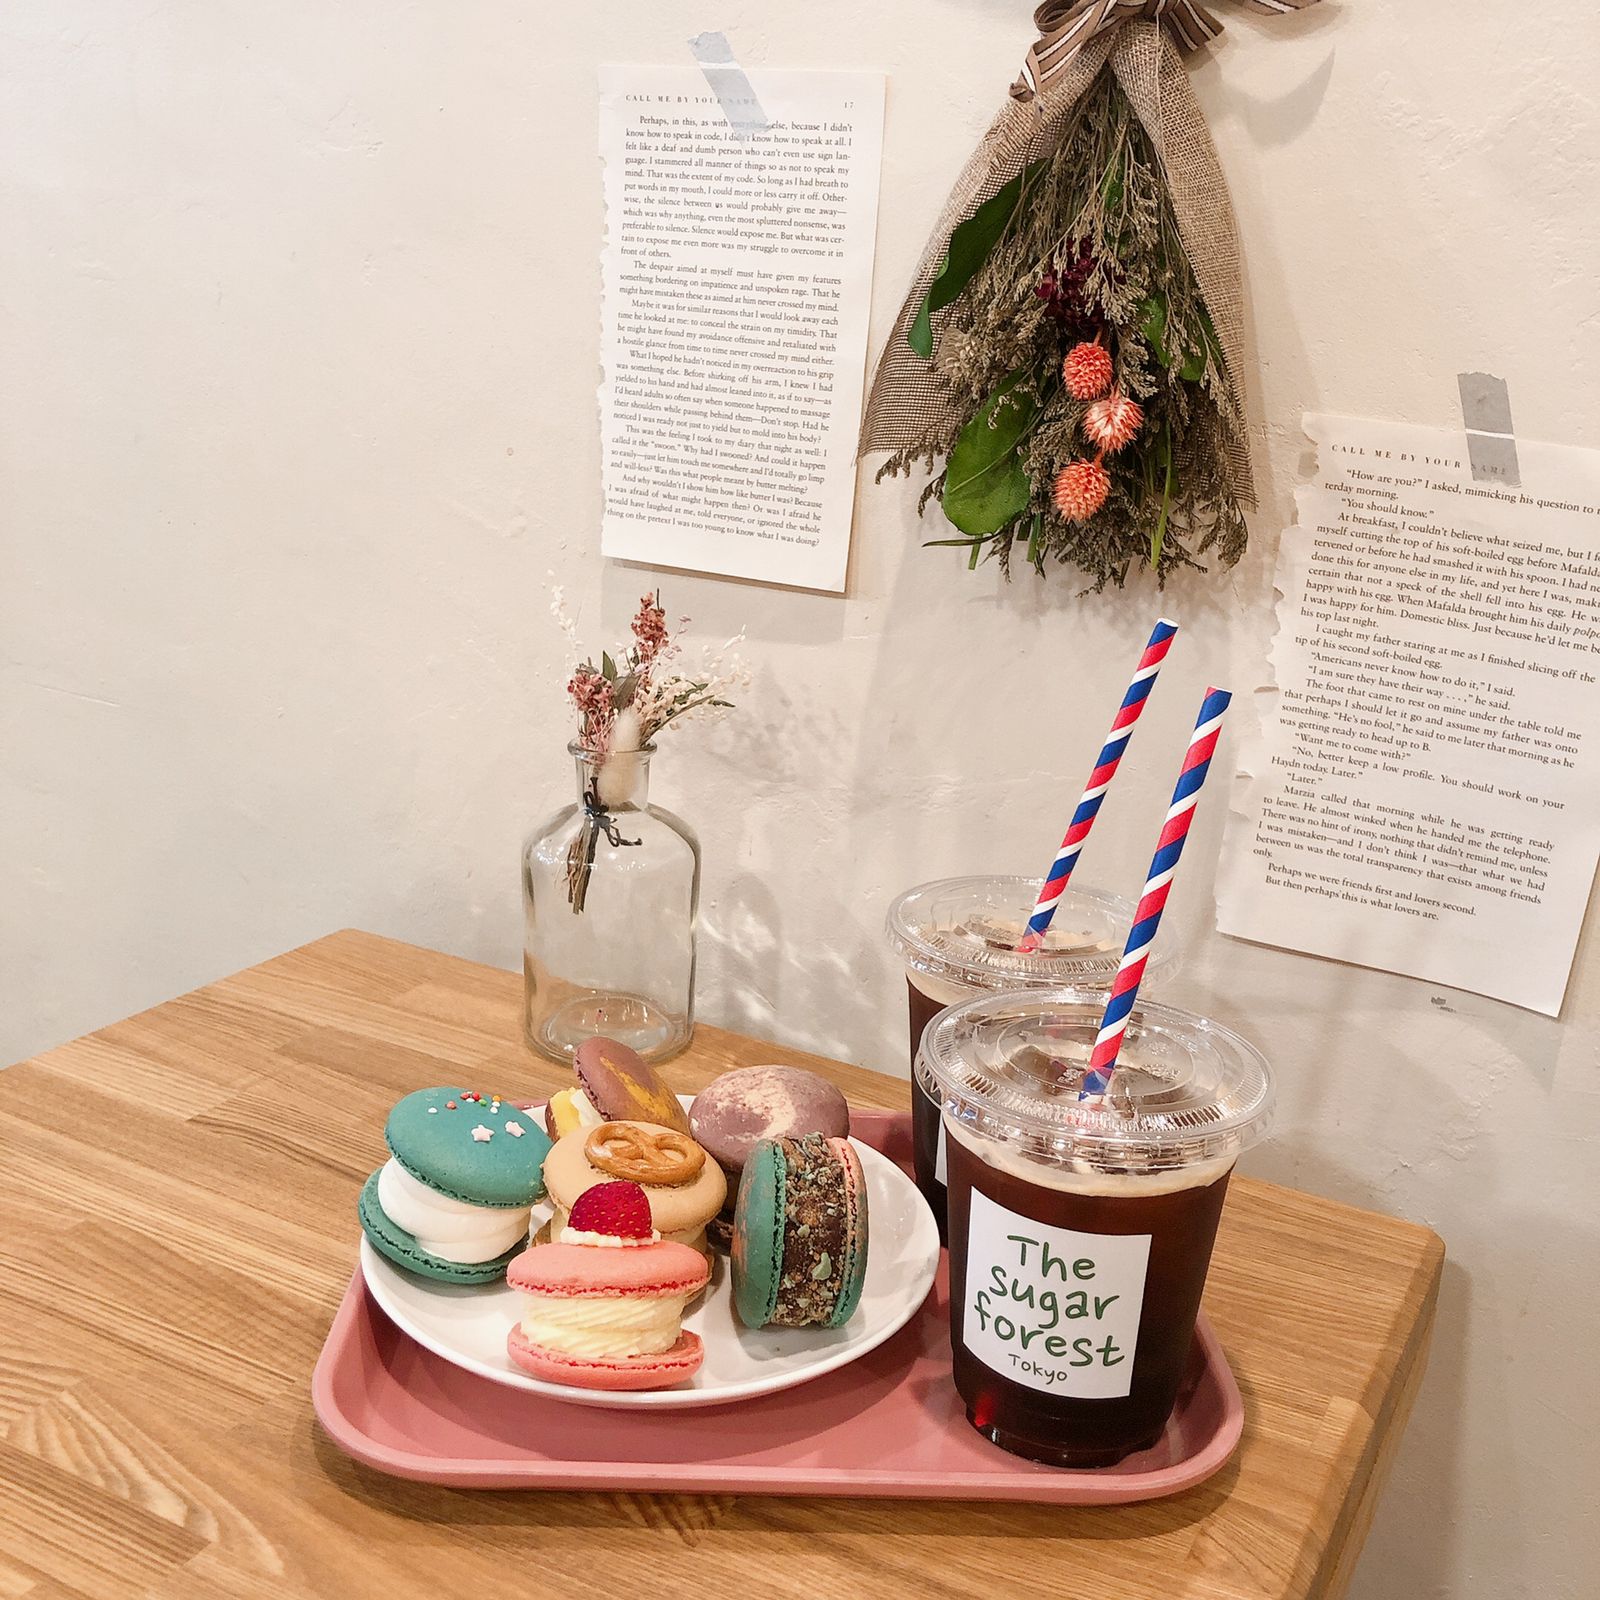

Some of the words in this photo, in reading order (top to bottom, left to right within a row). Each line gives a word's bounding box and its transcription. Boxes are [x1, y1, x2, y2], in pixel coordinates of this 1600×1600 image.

[625, 94, 651, 102] CALL
[625, 141, 637, 150] felt
[639, 141, 652, 151] like
[660, 142, 677, 152] deaf
[679, 144, 693, 153] and
[694, 144, 716, 154] dumb
[717, 148, 742, 156] person
[744, 146, 760, 156] who
[762, 148, 781, 157] can't
[817, 151, 833, 161] sign
[835, 150, 850, 160] lan-
[620, 245, 638, 255] front
[638, 247, 647, 256] of
[634, 260, 647, 269] The
[648, 261, 674, 272] despair
[676, 264, 697, 273] aimed
[710, 267, 733, 277] myself
[736, 270, 754, 278] must
[756, 269, 773, 279] have
[775, 271, 794, 282] given
[797, 275, 809, 284] my
[812, 274, 842, 285] features
[614, 385, 624, 394] I'd
[624, 386, 643, 396] heard
[643, 389, 664, 399] adults
[673, 393, 691, 402] often
[692, 397, 703, 405] say
[704, 396, 723, 406] when
[723, 401, 754, 409] someone
[755, 401, 790, 414] happened
[800, 409, 831, 420] massage
[1331, 444, 1365, 455] CALL
[1374, 449, 1391, 459] ME
[1400, 453, 1416, 462] BY
[1425, 456, 1460, 468] YOUR
[622, 473, 636, 483] And
[637, 475, 650, 486] why
[652, 479, 681, 489] wouldn't
[686, 482, 704, 492] show
[705, 484, 719, 494] him
[719, 486, 734, 496] how
[735, 488, 749, 499] like
[749, 490, 771, 501] butter
[776, 496, 794, 504] was?
[794, 496, 823, 509] Because
[1324, 480, 1354, 496] terday
[1341, 497, 1364, 509] "You
[1365, 501, 1399, 514] should
[1399, 505, 1434, 519] know."
[1300, 606, 1314, 617] his
[1315, 611, 1333, 622] top
[1333, 612, 1351, 623] last
[1352, 616, 1379, 628] night.
[1295, 634, 1308, 647] tip
[1309, 637, 1321, 647] of
[1322, 638, 1336, 649] his
[1337, 641, 1371, 655] second
[1371, 647, 1423, 665] soft-boiled
[1423, 659, 1443, 670] egg.
[1321, 627, 1353, 639] caught
[1355, 632, 1371, 643] my
[1372, 633, 1401, 646] father
[1402, 640, 1436, 655] staring
[1437, 647, 1448, 655] at
[1450, 649, 1465, 658] me
[1467, 652, 1478, 661] as
[1487, 654, 1526, 669] finished
[1526, 662, 1559, 678] slicing
[1561, 669, 1577, 679] off
[1579, 672, 1596, 683] the
[1363, 662, 1390, 673] never
[1390, 664, 1418, 678] know
[1419, 670, 1440, 682] how
[1441, 676, 1452, 684] to
[1453, 677, 1467, 687] do
[1468, 679, 1485, 691] it,"
[1492, 686, 1515, 697] said.
[1306, 678, 1323, 689] The
[1325, 681, 1345, 693] foot
[1347, 686, 1366, 697] that
[1367, 691, 1393, 702] came
[1395, 696, 1405, 704] to
[1407, 698, 1425, 708] rest
[1427, 702, 1440, 711] on
[1442, 704, 1467, 716] mine
[1469, 710, 1497, 722] under
[1499, 715, 1515, 726] the
[1517, 720, 1541, 732] table
[1543, 725, 1564, 737] told
[1566, 731, 1582, 740] me
[1279, 717, 1296, 726] was
[1297, 721, 1330, 734] getting
[1331, 727, 1357, 739] ready
[1358, 731, 1369, 740] to
[1370, 731, 1394, 744] head
[1395, 739, 1408, 749] up
[1409, 741, 1420, 750] to
[1421, 741, 1431, 752] B.
[1291, 745, 1314, 758] "No,
[1317, 749, 1344, 763] better
[1347, 755, 1369, 769] keep
[1382, 762, 1400, 773] low
[1441, 774, 1458, 786] You
[1461, 779, 1494, 794] should
[1497, 788, 1522, 800] work
[1525, 795, 1539, 804] on
[1541, 799, 1565, 810] your
[1255, 833, 1291, 848] between
[1293, 842, 1304, 850] us
[1306, 845, 1324, 854] was
[1326, 847, 1341, 858] the
[1342, 852, 1364, 863] total
[1366, 857, 1424, 877] transparency
[1426, 869, 1445, 881] that
[1446, 875, 1472, 887] exists
[1474, 882, 1507, 898] among
[1509, 888, 1542, 904] friends
[1267, 862, 1302, 879] Perhaps
[1304, 871, 1318, 880] we
[1318, 874, 1340, 885] were
[1341, 877, 1373, 892] friends
[1374, 884, 1393, 896] first
[1394, 891, 1413, 901] and
[1413, 893, 1440, 907] lovers
[1442, 902, 1476, 916] second.
[1007, 1235, 1096, 1281] The
[974, 1291, 1125, 1367] forest
[1008, 1353, 1068, 1385] Tokyo
